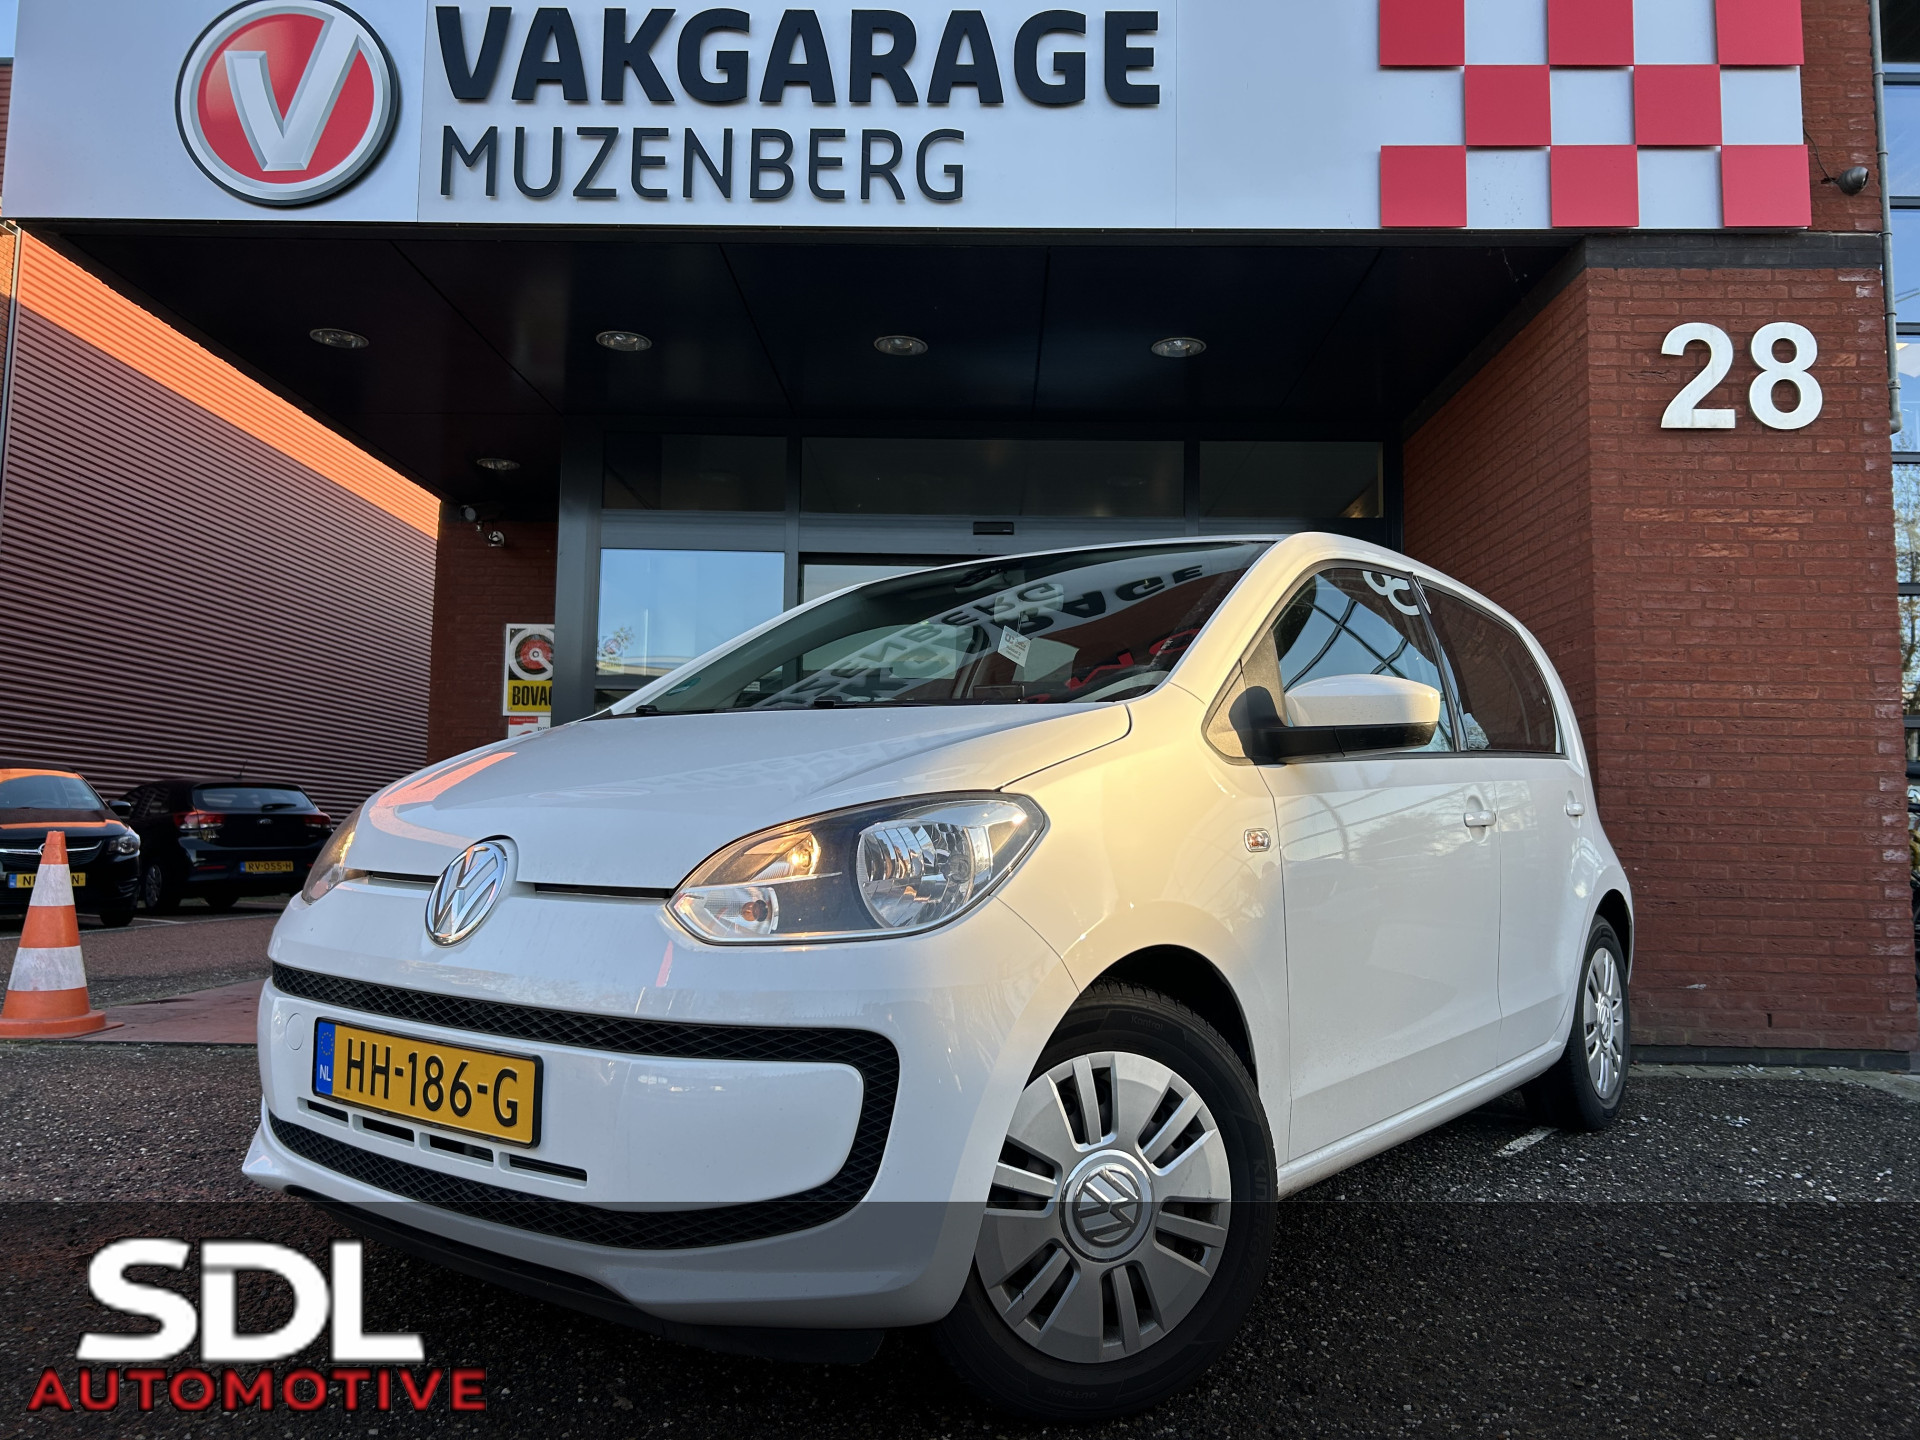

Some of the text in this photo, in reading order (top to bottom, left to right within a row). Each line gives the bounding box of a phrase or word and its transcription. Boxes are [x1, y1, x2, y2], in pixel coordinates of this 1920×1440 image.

[436, 6, 1160, 107] VAKGARAGE
[441, 126, 965, 201] MUZENBERG
[1661, 322, 1823, 430] 28
[512, 685, 552, 706] BOVA
[319, 1063, 332, 1082] NL
[345, 1037, 519, 1128] HH-186-G
